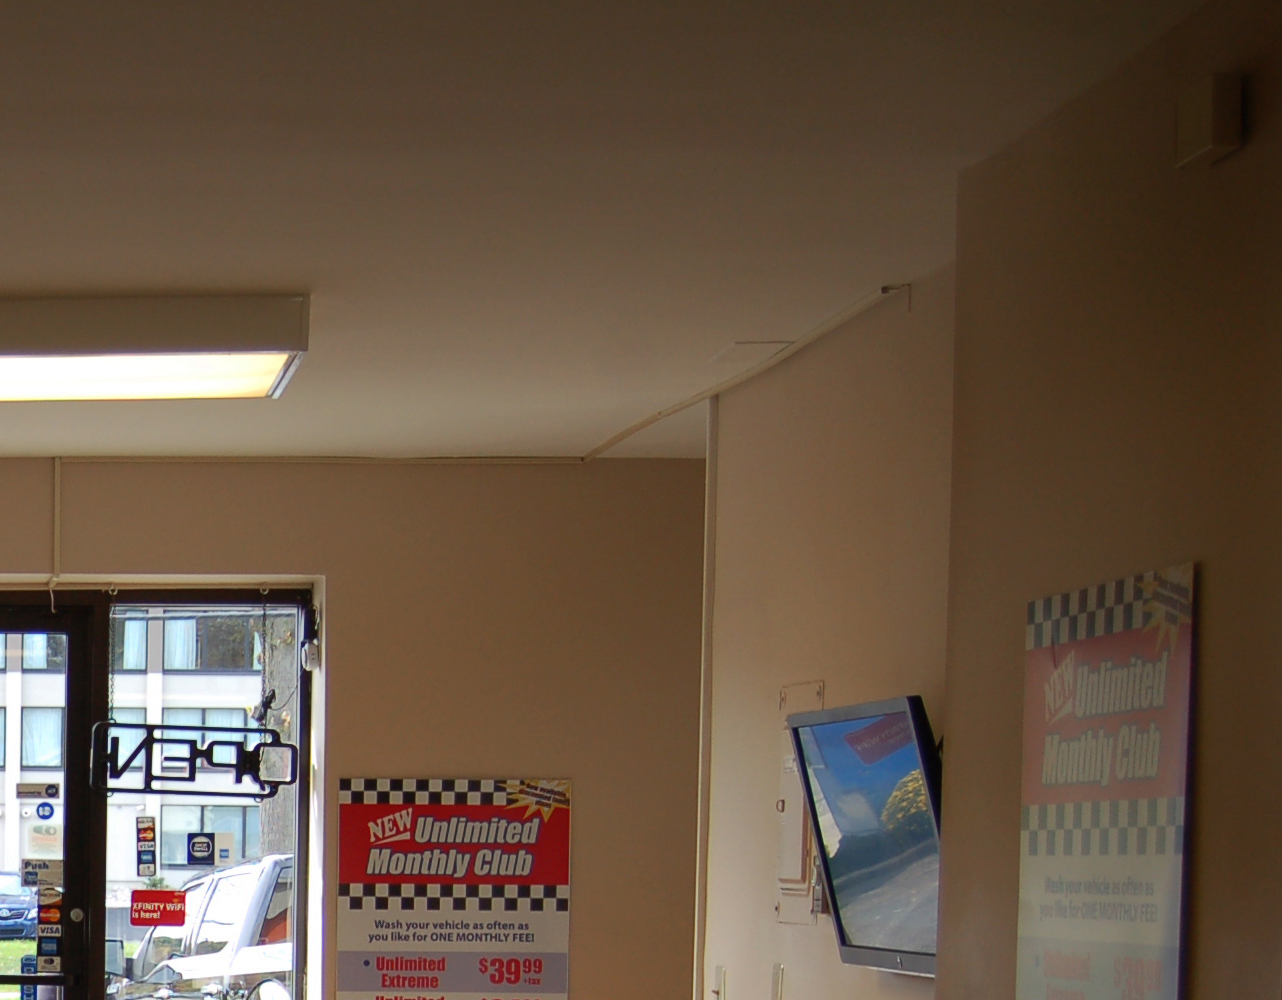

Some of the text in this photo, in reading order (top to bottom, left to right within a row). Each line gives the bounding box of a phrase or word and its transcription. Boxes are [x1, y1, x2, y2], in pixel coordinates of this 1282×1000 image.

[1044, 649, 1169, 722] NEW Unlimited
[1042, 721, 1161, 787] Monthly Club
[368, 807, 539, 844] NEW Unlimited
[25, 861, 49, 870] Push
[367, 848, 533, 878] Monthly Club
[133, 902, 165, 910] XFINITY
[40, 926, 60, 935] VISA
[374, 919, 529, 932] Wash your vehicle as often as
[368, 932, 535, 944] you like for ONE MONTHLY FEE!
[375, 956, 446, 972] Unlimited
[381, 974, 439, 989] Extreme
